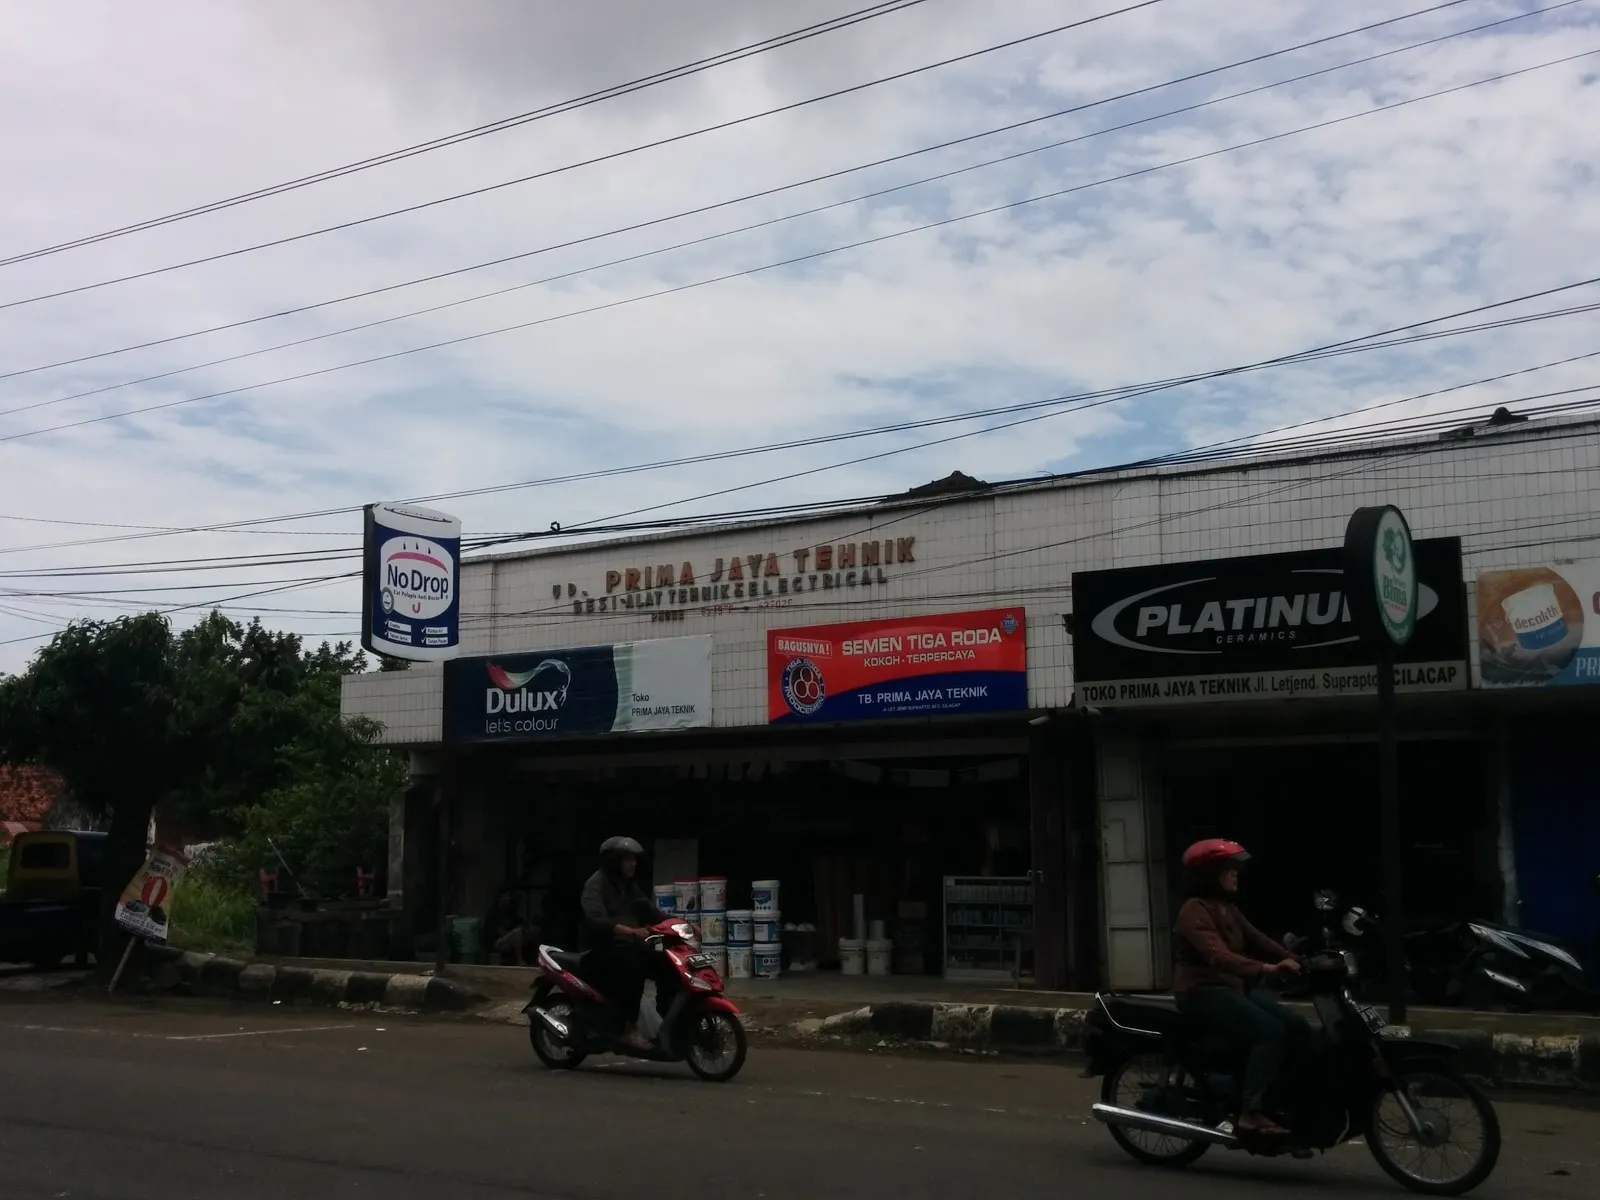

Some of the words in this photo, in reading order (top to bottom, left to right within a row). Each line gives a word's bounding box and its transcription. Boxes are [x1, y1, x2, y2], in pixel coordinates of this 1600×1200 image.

[606, 561, 695, 593] PRIMA
[709, 552, 780, 582] JAYA
[793, 536, 916, 573] TEHNIK
[748, 567, 888, 597] ELECTRICAL
[1515, 605, 1560, 629] decolith
[841, 636, 903, 656] SEMEN
[906, 632, 947, 650] TIGA
[951, 627, 1003, 646] RODA
[1215, 629, 1297, 645] CERAMICS
[777, 639, 831, 655] BAGUSNYA!
[863, 656, 901, 667] KOKOH
[906, 649, 976, 665] TERPERCAYA
[631, 693, 650, 703] Toko
[857, 693, 875, 705] TB.
[877, 691, 912, 704] PRIMA
[914, 688, 943, 701] JAYA
[946, 686, 989, 699] TEKNIK
[1082, 685, 1116, 702] TOKO
[1120, 683, 1160, 700] PRIMA
[1164, 681, 1196, 697] JAYA
[1199, 678, 1251, 696] TEKNIK
[485, 686, 559, 715] Dulux
[631, 705, 653, 717] PRIMA
[653, 705, 671, 716] JAYA
[671, 704, 696, 715] TEKNIK
[485, 718, 511, 734] let's
[514, 717, 559, 732] colour
